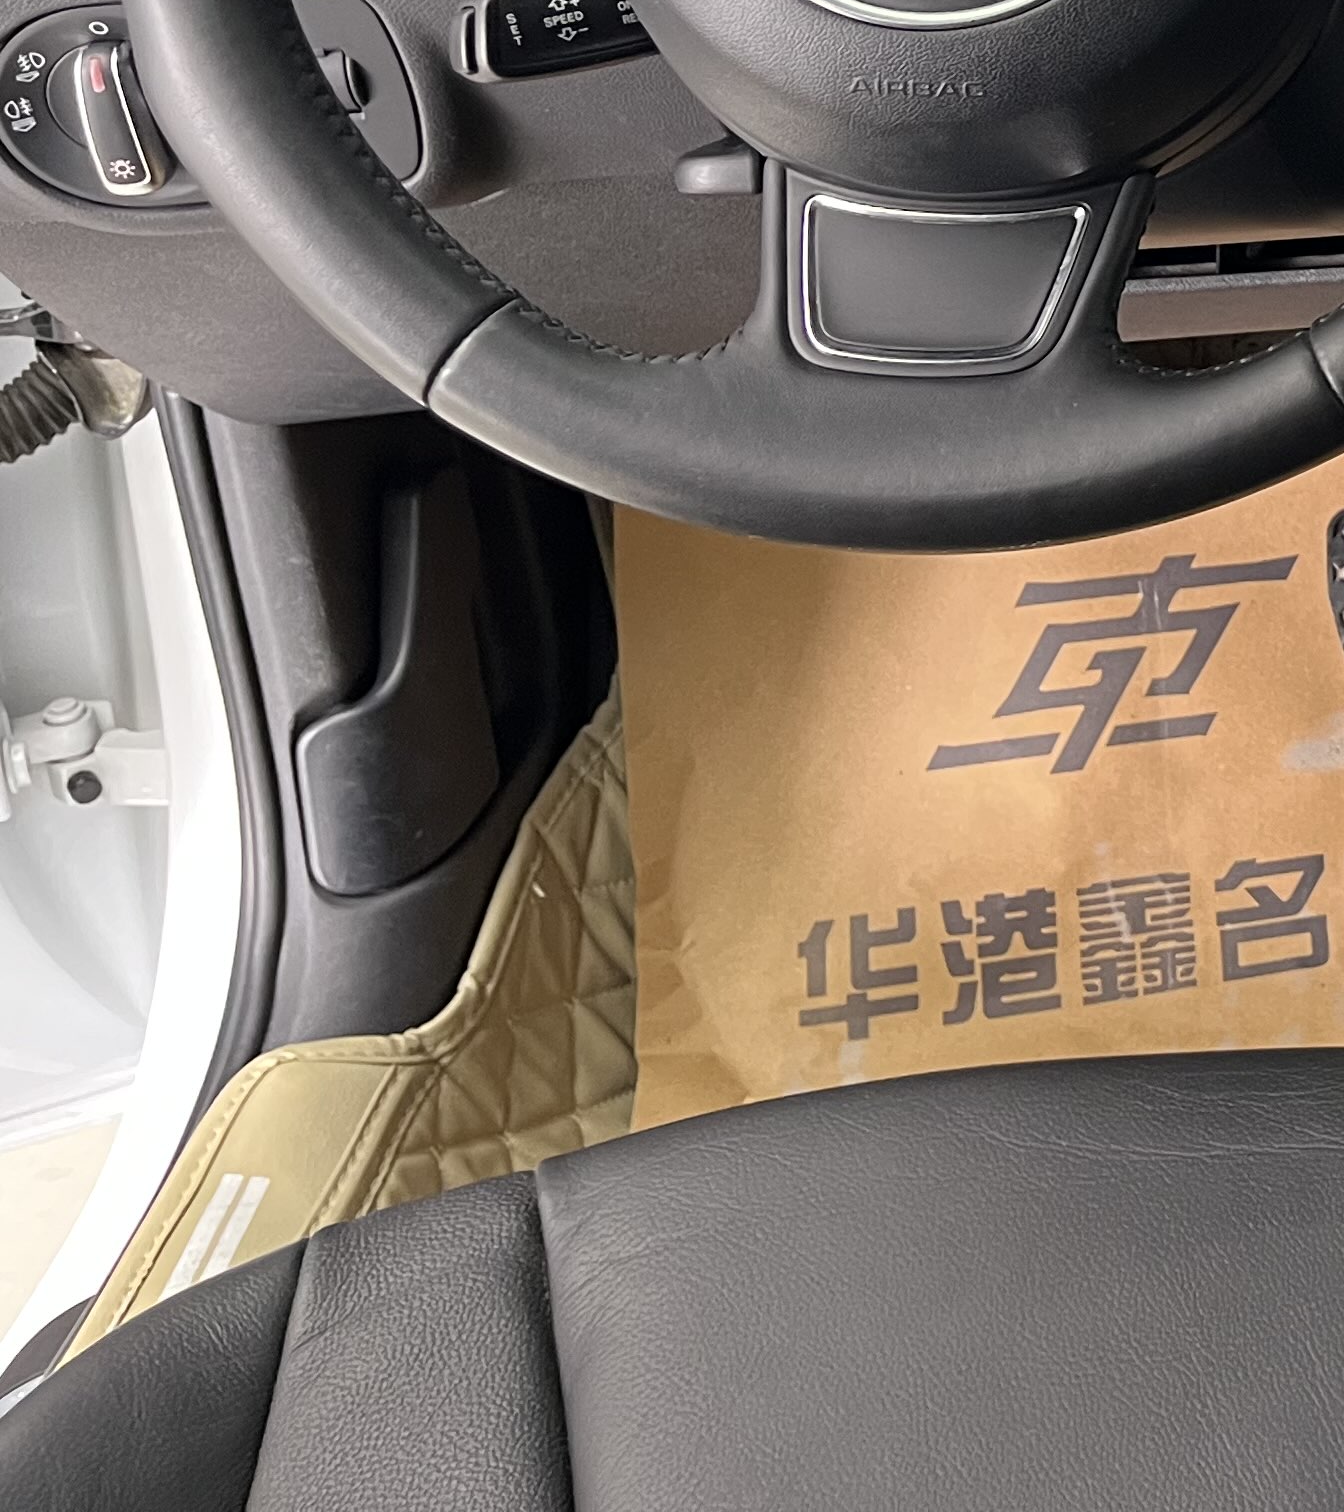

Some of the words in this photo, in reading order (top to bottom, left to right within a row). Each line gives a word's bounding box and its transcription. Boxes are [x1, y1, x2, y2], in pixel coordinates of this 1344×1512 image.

[505, 12, 522, 46] SET
[543, 11, 584, 29] SPEED
[850, 71, 986, 98] AIRBAG
